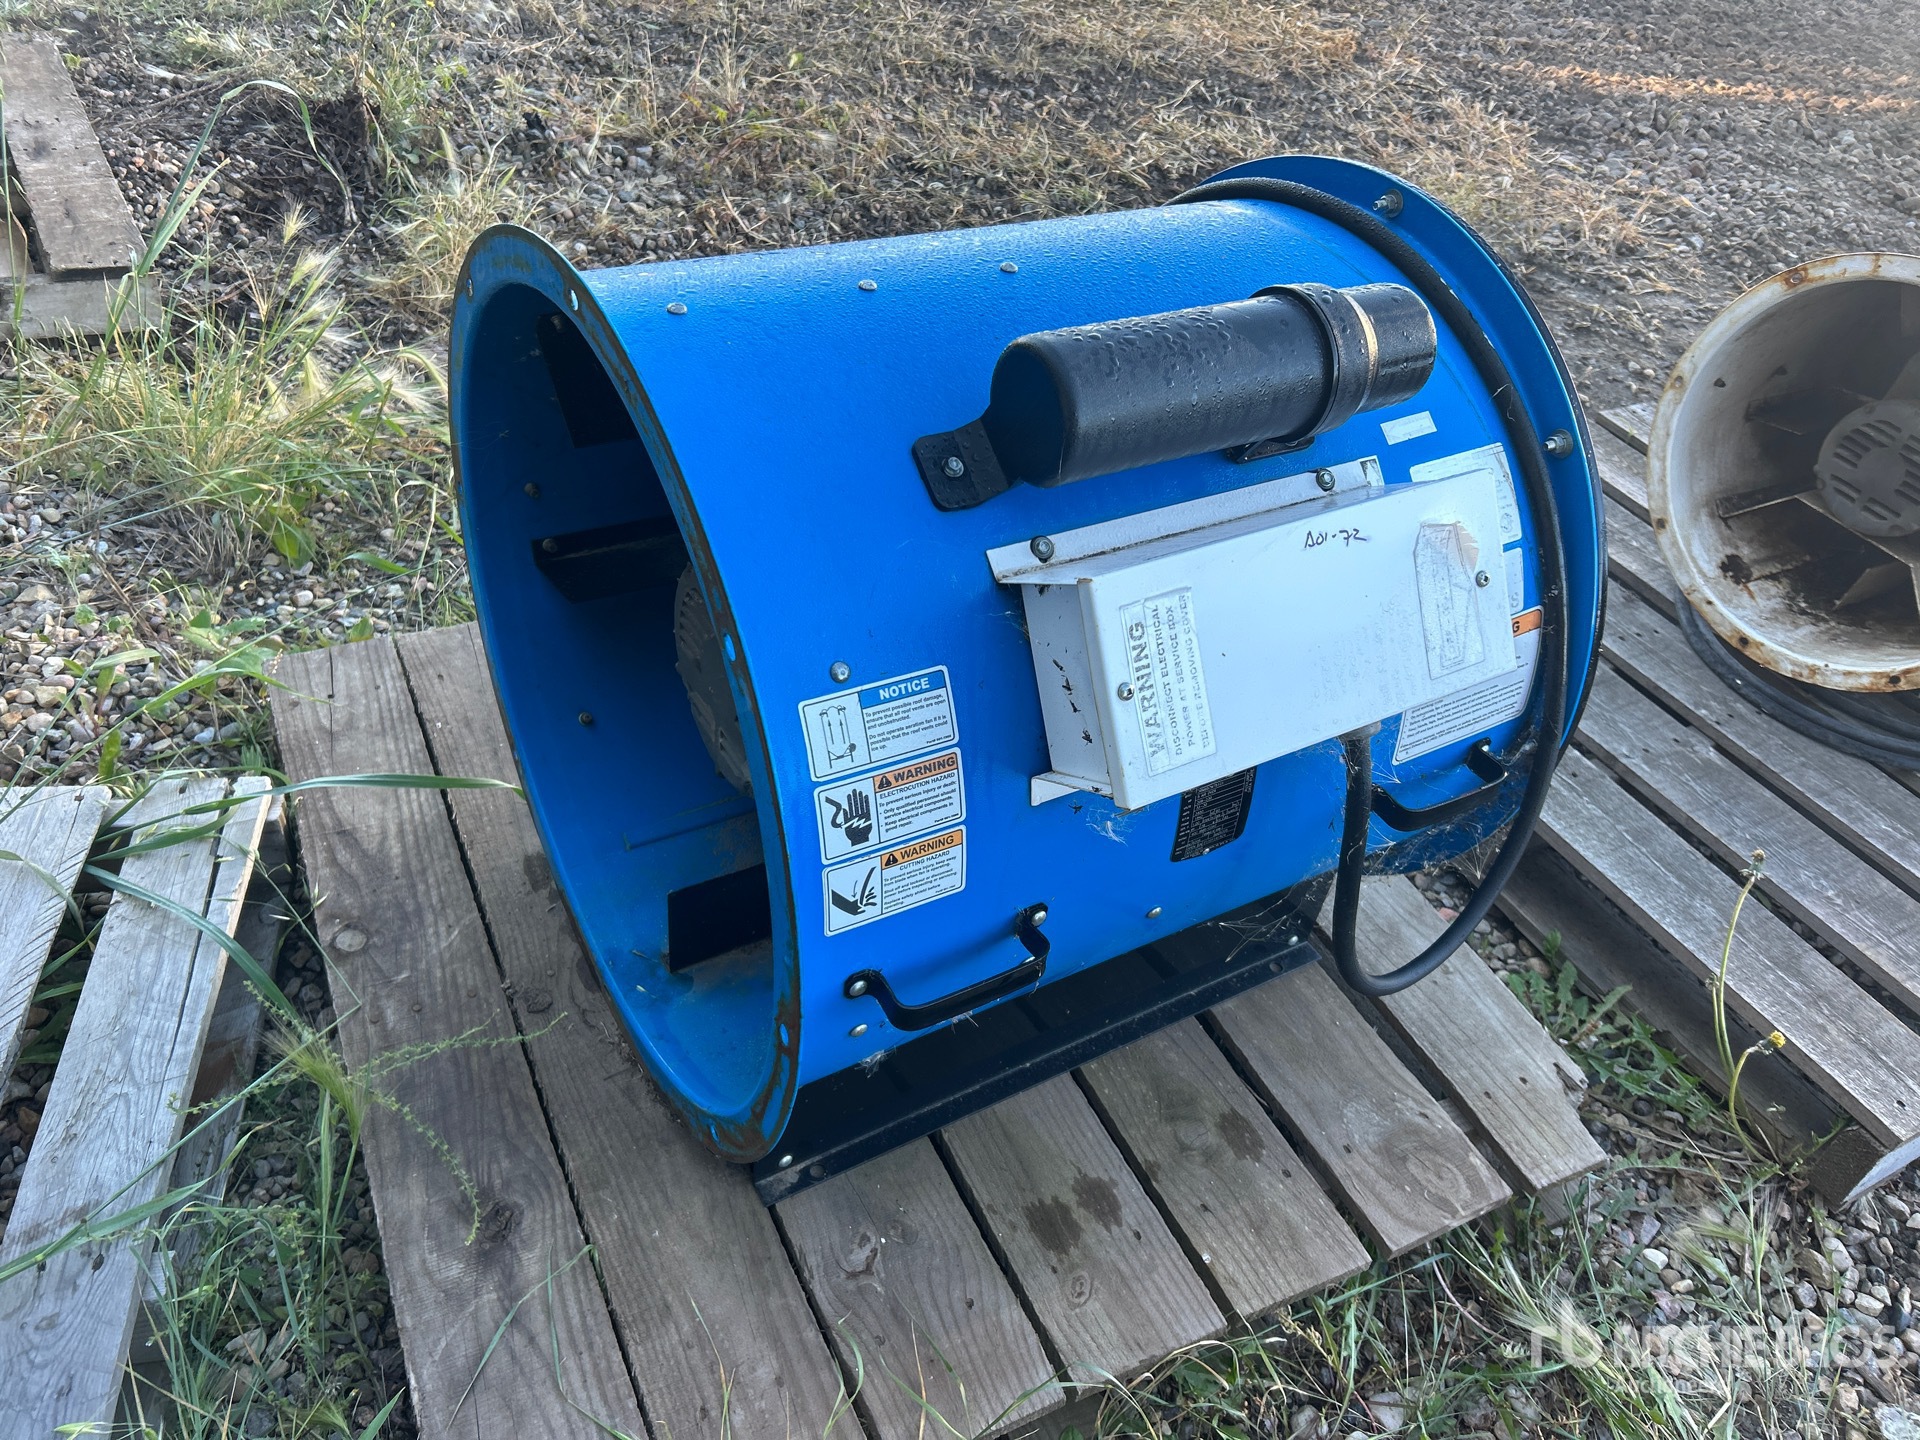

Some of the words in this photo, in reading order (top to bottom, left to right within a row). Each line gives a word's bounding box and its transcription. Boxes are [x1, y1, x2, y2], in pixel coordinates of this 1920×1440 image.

[1166, 606, 1176, 630] BOX
[1151, 605, 1169, 678] ELECTRICAL
[1169, 633, 1185, 683] SERVICE
[879, 678, 930, 700] NOTICE
[1129, 621, 1165, 758] WARNING
[872, 707, 890, 716] prevent
[892, 702, 911, 711] possible
[923, 694, 943, 702] damage,
[1162, 681, 1183, 756] DISCONNECT
[1183, 706, 1196, 747] POWER
[870, 736, 890, 745] possible
[886, 727, 904, 735] operate
[893, 757, 955, 782] WARNING
[880, 780, 930, 799] ELECTROCUTION
[931, 772, 955, 783] HAZARD
[886, 797, 904, 806] prevent
[905, 792, 921, 800] serious
[901, 835, 954, 859] WARNING
[900, 859, 925, 870] CUTTING
[926, 850, 950, 862] HAZARD
